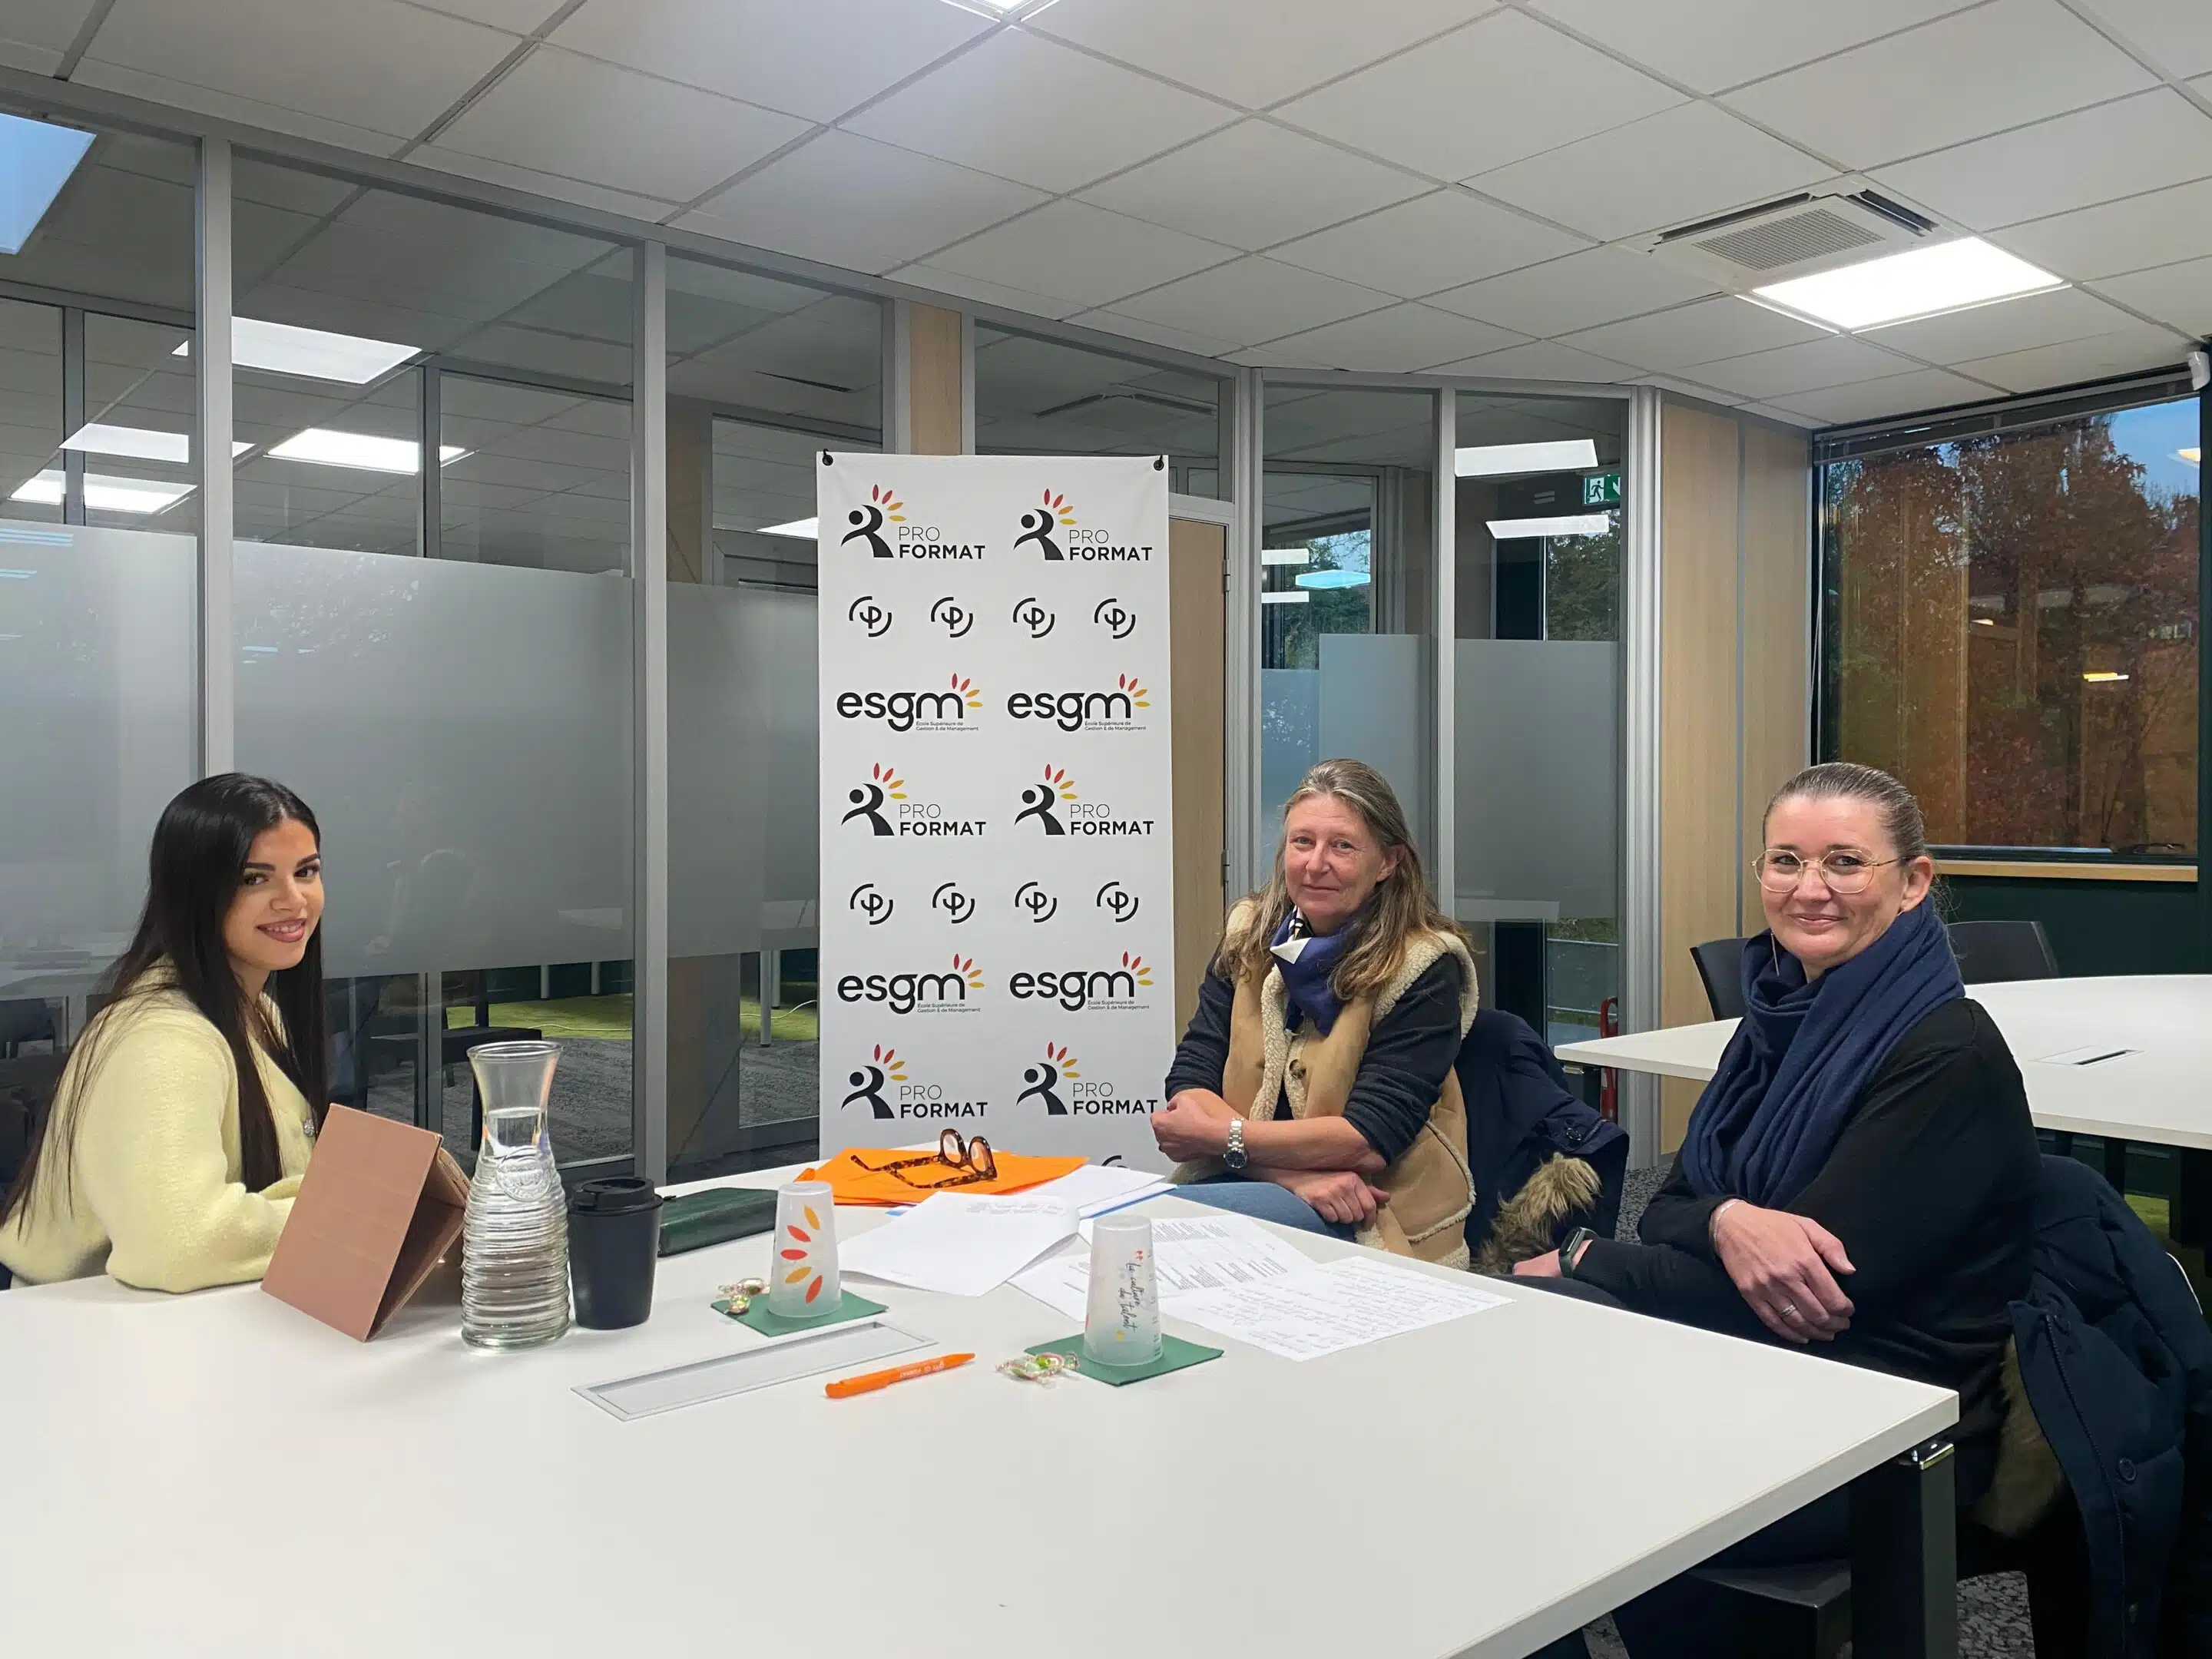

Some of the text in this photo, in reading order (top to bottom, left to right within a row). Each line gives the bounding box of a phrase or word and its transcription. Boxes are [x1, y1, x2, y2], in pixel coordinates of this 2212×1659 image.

[899, 526, 941, 542] PRO
[1068, 528, 1110, 544] PRO
[899, 544, 986, 560] FORMAT
[1069, 546, 1153, 561] FORMAT
[836, 691, 964, 732] esgm
[1007, 691, 1131, 732] esgm
[899, 803, 942, 820] PRO
[1070, 803, 1111, 819] PRO
[899, 821, 987, 836] FORMAT
[1070, 820, 1154, 836] FORMAT
[837, 972, 966, 1015] esgm
[1009, 970, 1135, 1012] esgm
[899, 1084, 942, 1101] PRO
[1072, 1081, 1114, 1098] PRO
[900, 1101, 988, 1119] FORMAT
[1073, 1099, 1158, 1115] FORMAT
[1125, 1263, 1145, 1306] La culture
[1120, 1301, 1139, 1334] talent
